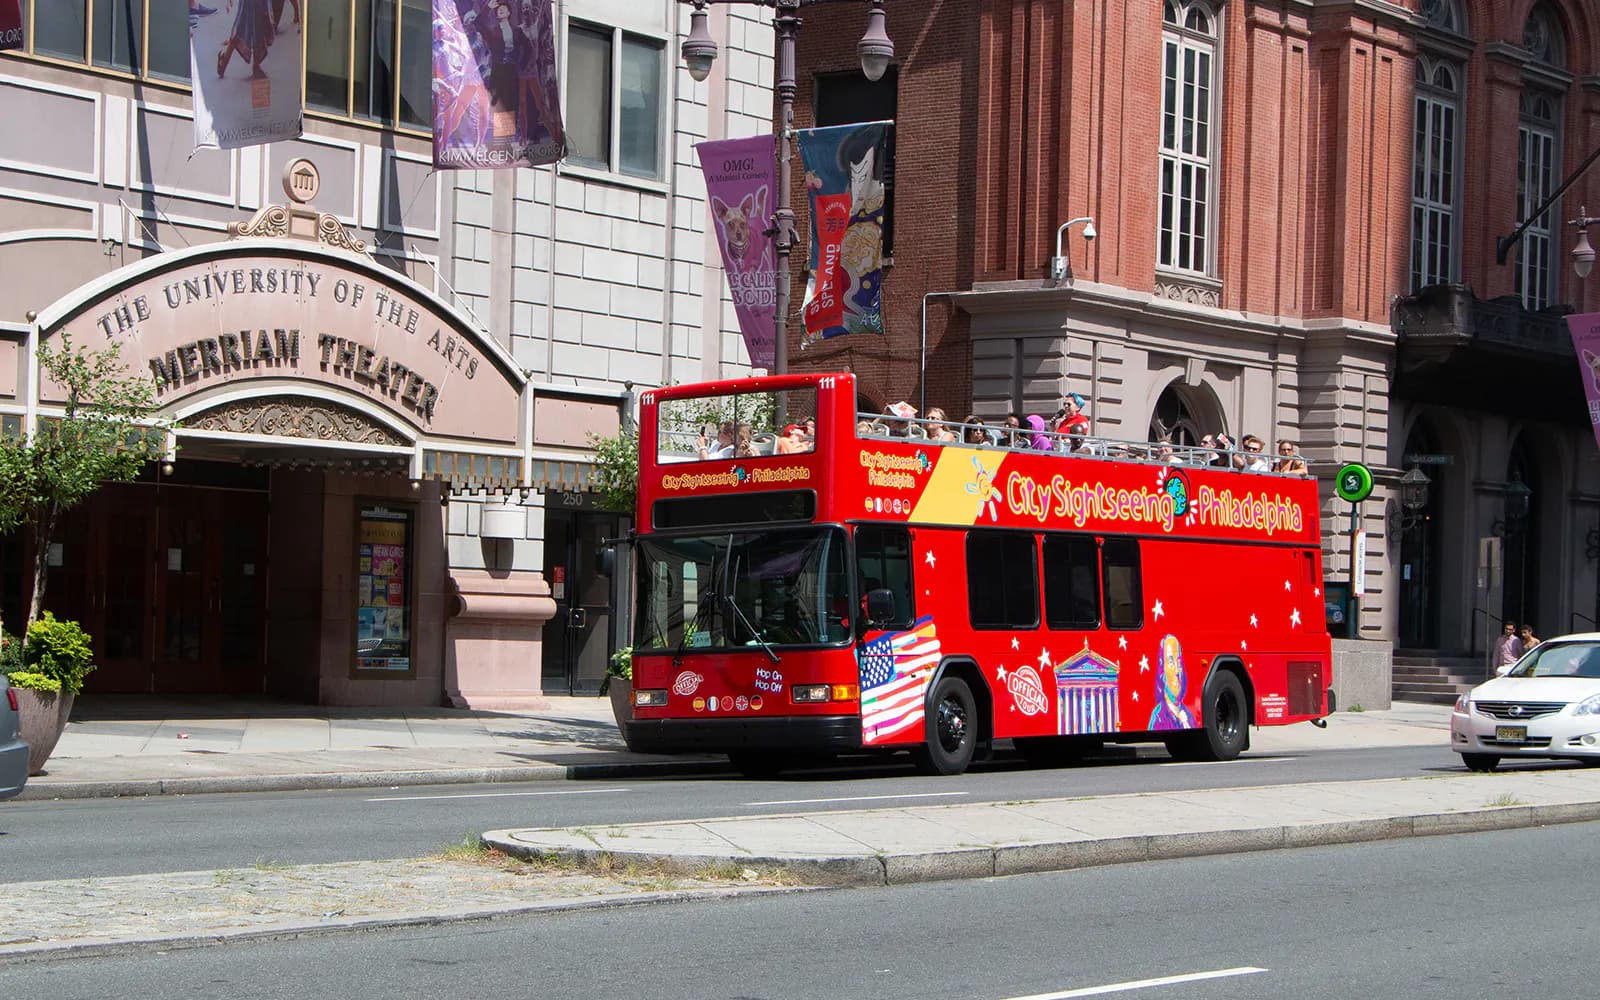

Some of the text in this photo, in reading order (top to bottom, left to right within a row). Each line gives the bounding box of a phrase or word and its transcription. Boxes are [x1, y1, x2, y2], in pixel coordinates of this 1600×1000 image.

[439, 143, 560, 162] KIMMELCENTER.ORG
[723, 158, 754, 172] OMG!
[97, 268, 479, 380] THE UNIVERSITY OF THE ARTS
[149, 329, 439, 422] MERRIAM THEATER
[819, 377, 835, 390] 111
[641, 393, 655, 405] 111
[752, 466, 810, 483] Philadelphia
[868, 469, 915, 490] Philadelphia
[562, 492, 583, 506] 250
[1199, 485, 1303, 535] Philadelphia
[756, 668, 783, 680] Hop On
[755, 679, 783, 693] Hop Off
[1012, 677, 1046, 707] OFFICIAL
